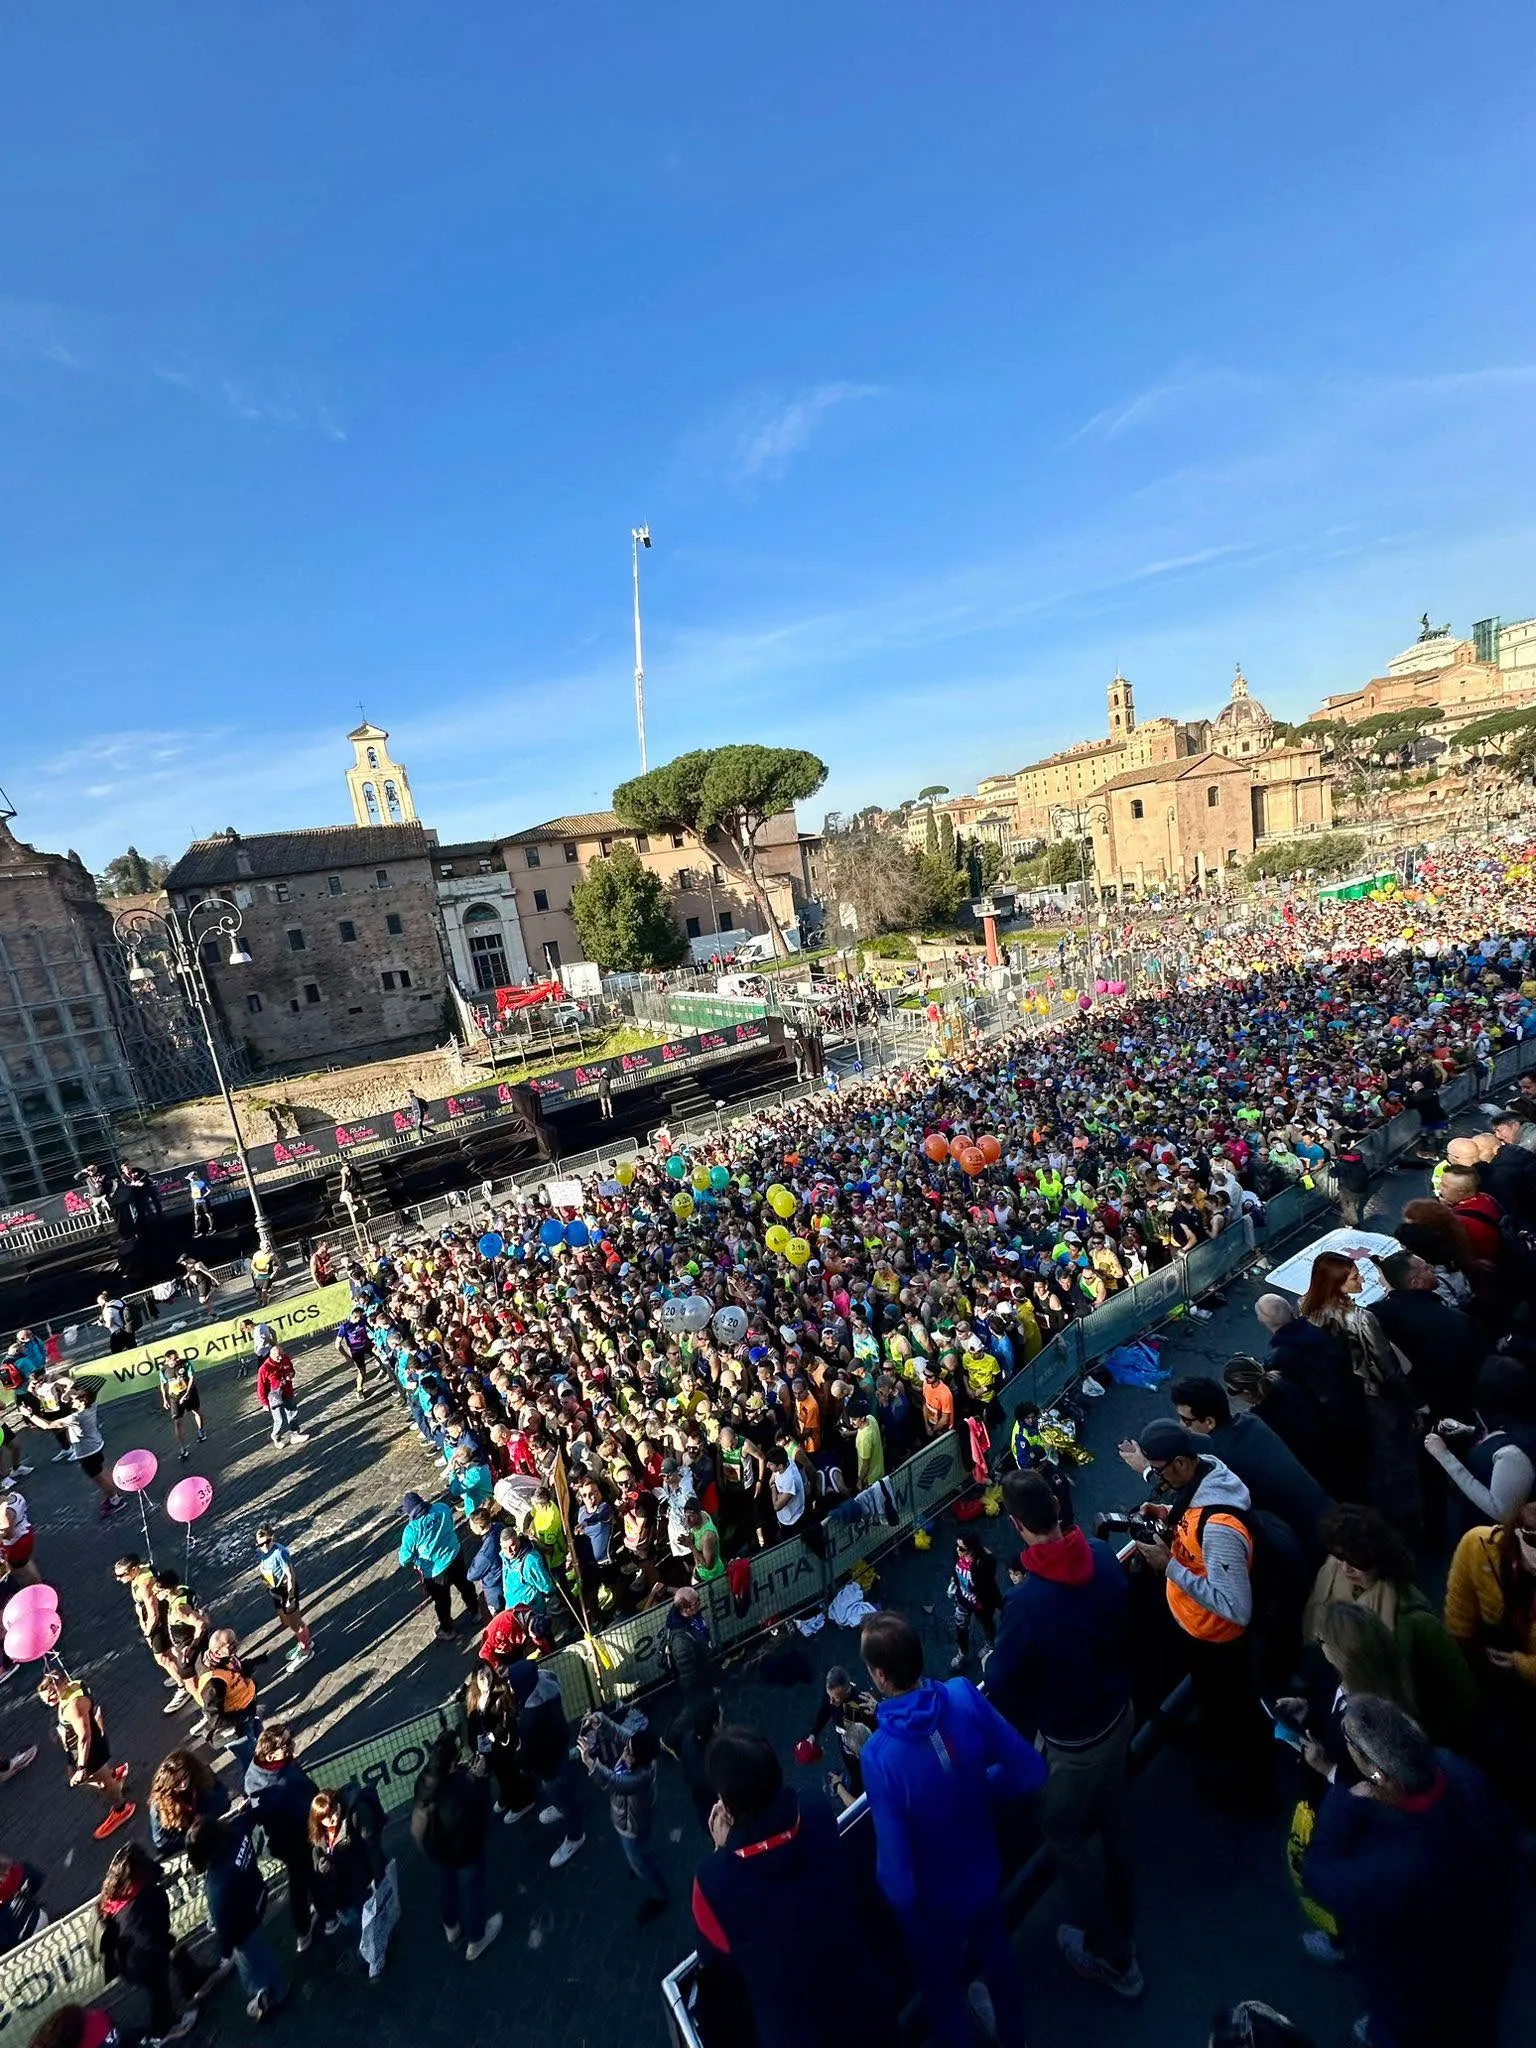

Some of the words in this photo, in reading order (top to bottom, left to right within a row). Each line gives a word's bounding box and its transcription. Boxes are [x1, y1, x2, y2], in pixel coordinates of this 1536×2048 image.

[349, 1125, 366, 1134] RUN
[288, 1141, 306, 1151] RUN
[1, 1209, 24, 1221] RUN
[113, 1347, 199, 1383] WORD
